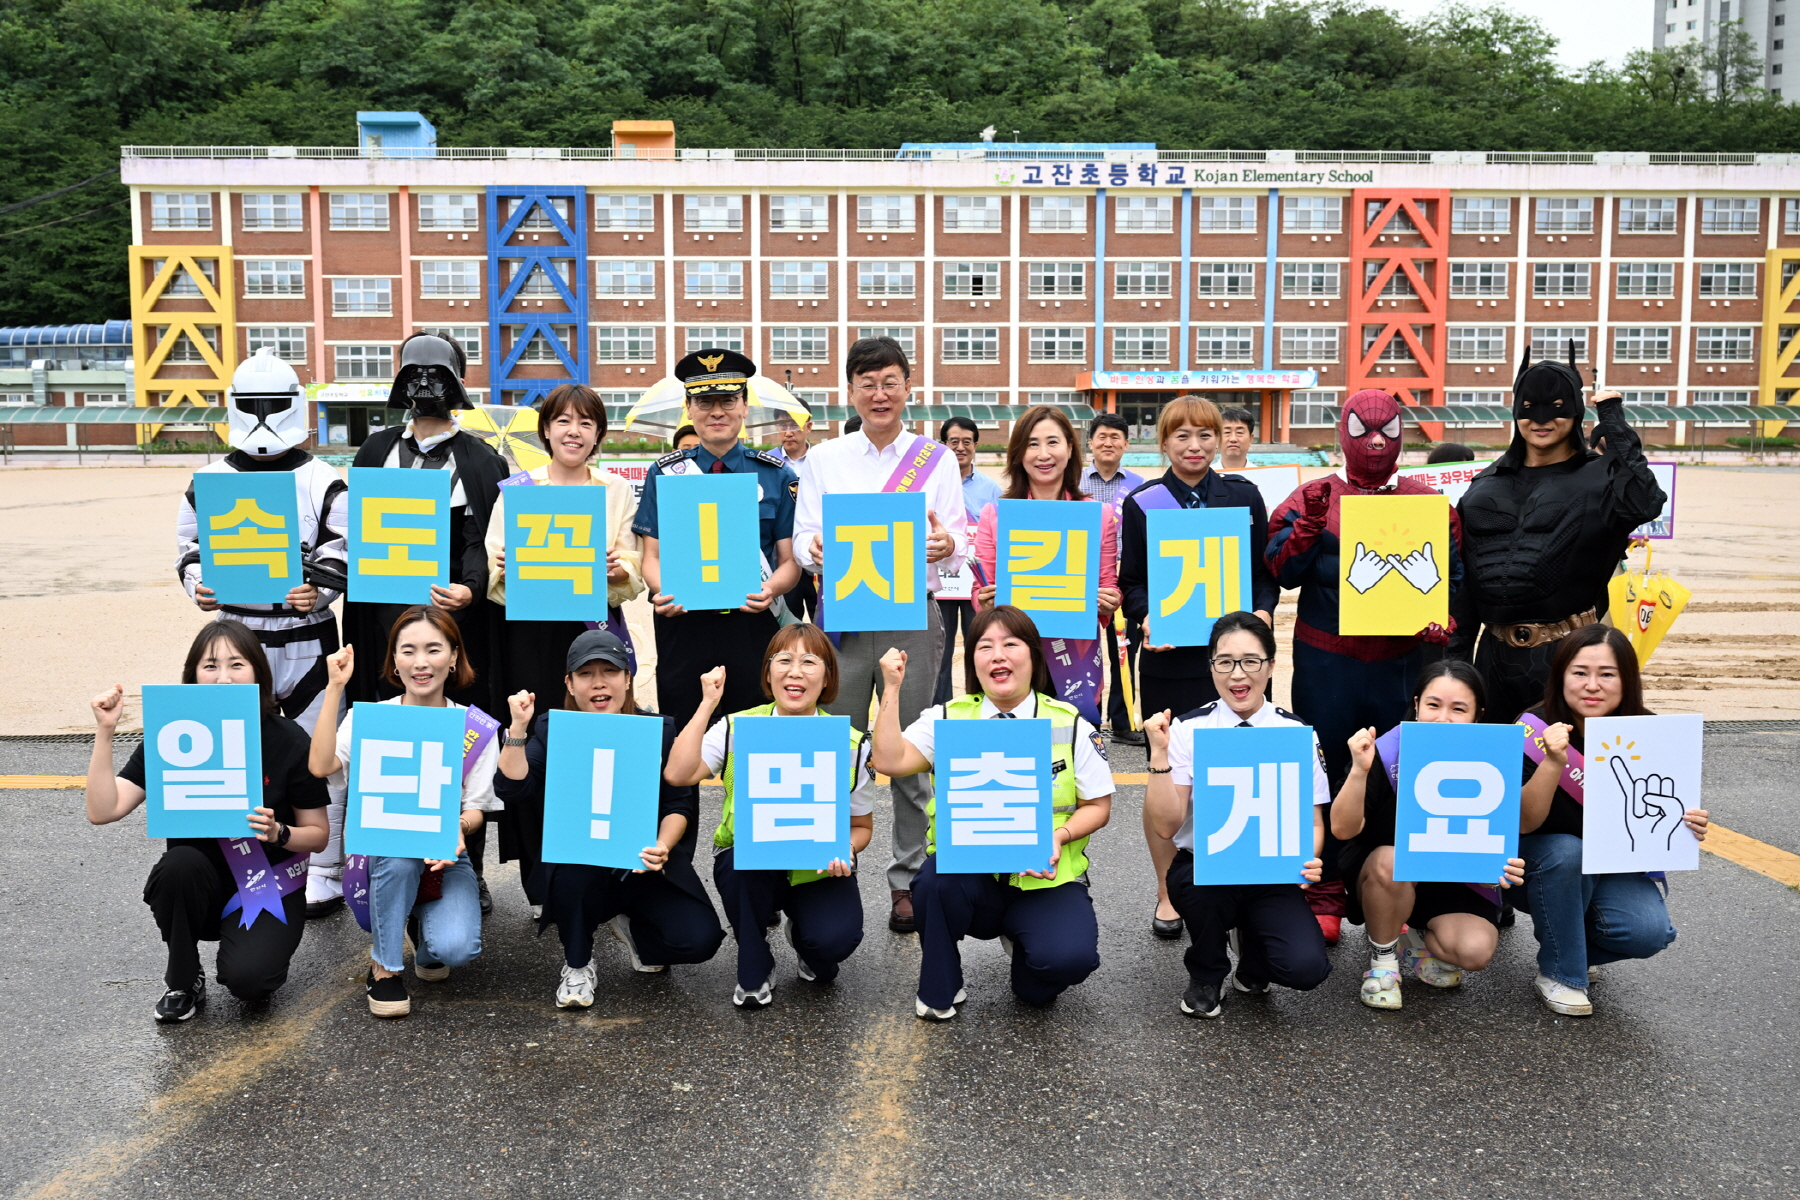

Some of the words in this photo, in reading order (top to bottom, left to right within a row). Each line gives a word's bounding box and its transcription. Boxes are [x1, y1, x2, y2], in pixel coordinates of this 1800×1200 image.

[1022, 163, 1187, 187] 고잔초등학교
[1194, 168, 1239, 184] Kojan
[1242, 169, 1326, 185] Elementary
[1328, 169, 1374, 184] School
[1110, 374, 1129, 385] 바른
[1135, 374, 1165, 385] 인성과
[1171, 374, 1190, 385] 꿈을
[1200, 374, 1240, 385] 키워가는
[1246, 374, 1276, 385] 행복한
[1281, 374, 1301, 385] 학교
[209, 498, 290, 578] 속
[358, 497, 439, 577] 도
[515, 514, 596, 595] 꼭
[835, 521, 915, 604] 지
[1007, 529, 1088, 612] 킬
[1160, 536, 1241, 618] 게
[158, 718, 250, 812] 일
[358, 738, 453, 834] 단
[747, 750, 837, 843] 멈
[947, 751, 1040, 846] 출
[1206, 761, 1301, 858] 게
[1408, 760, 1506, 855] 요
